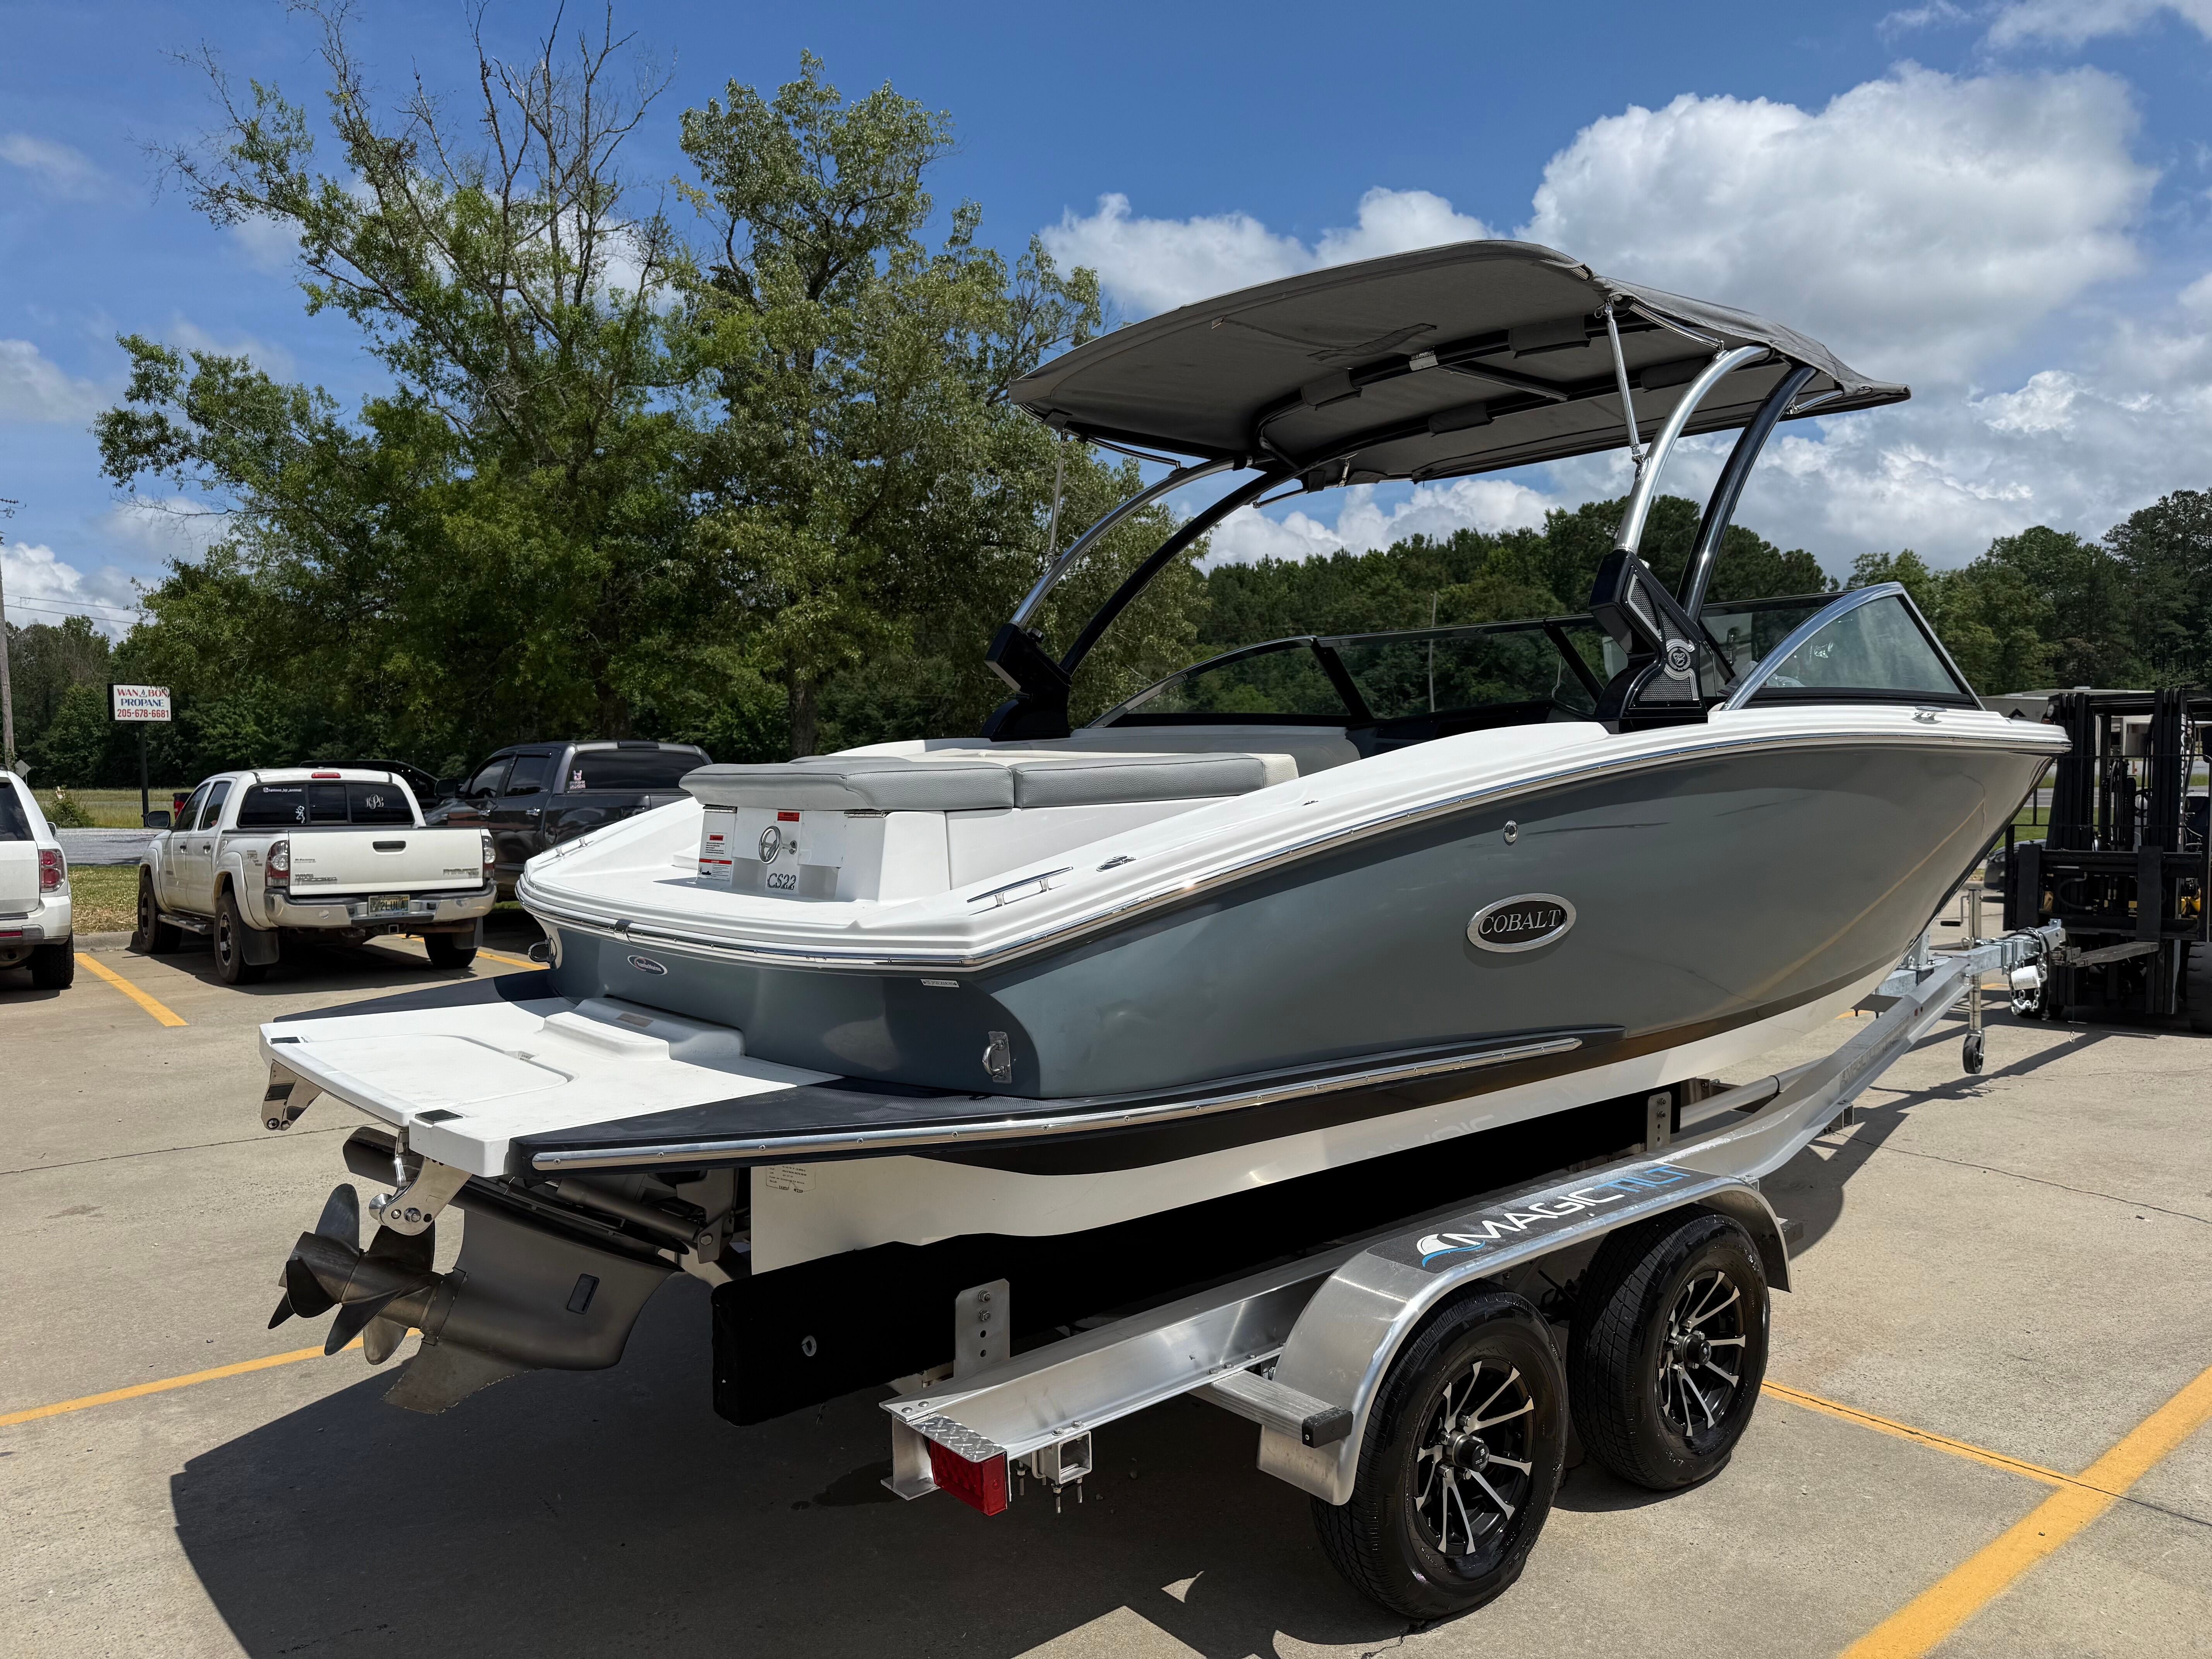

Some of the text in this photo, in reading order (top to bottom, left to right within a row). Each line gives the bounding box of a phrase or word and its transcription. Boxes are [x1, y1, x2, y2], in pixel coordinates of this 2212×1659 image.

[121, 699, 165, 707] PROPANE
[117, 709, 169, 718] 205-678-6681
[767, 873, 796, 890] CS22
[1479, 909, 1561, 934] COBALT
